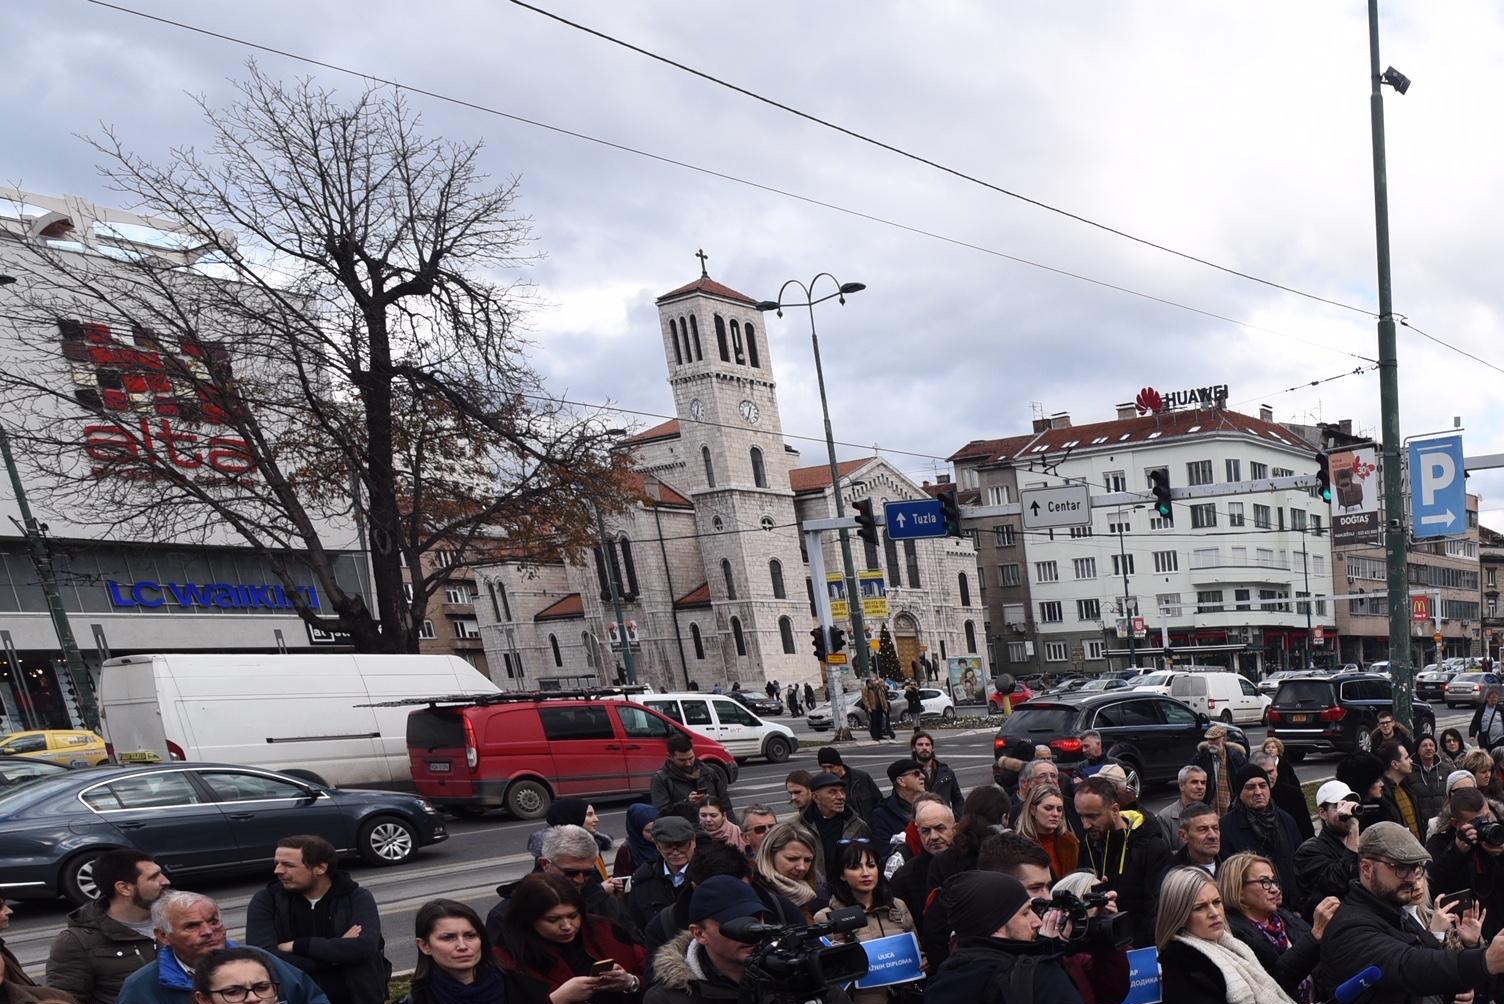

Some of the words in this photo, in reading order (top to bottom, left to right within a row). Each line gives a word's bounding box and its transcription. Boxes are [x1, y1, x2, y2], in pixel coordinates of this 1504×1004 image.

[1165, 384, 1228, 410] HUAWEI
[84, 416, 258, 473] alta
[1420, 452, 1455, 506] P
[1047, 500, 1081, 513] Centar
[912, 513, 937, 525] Tuzla
[107, 580, 164, 608] LC
[878, 952, 895, 960] ULICA
[886, 958, 912, 968] DIPLOMA
[1131, 977, 1158, 987] ДОДИКА
